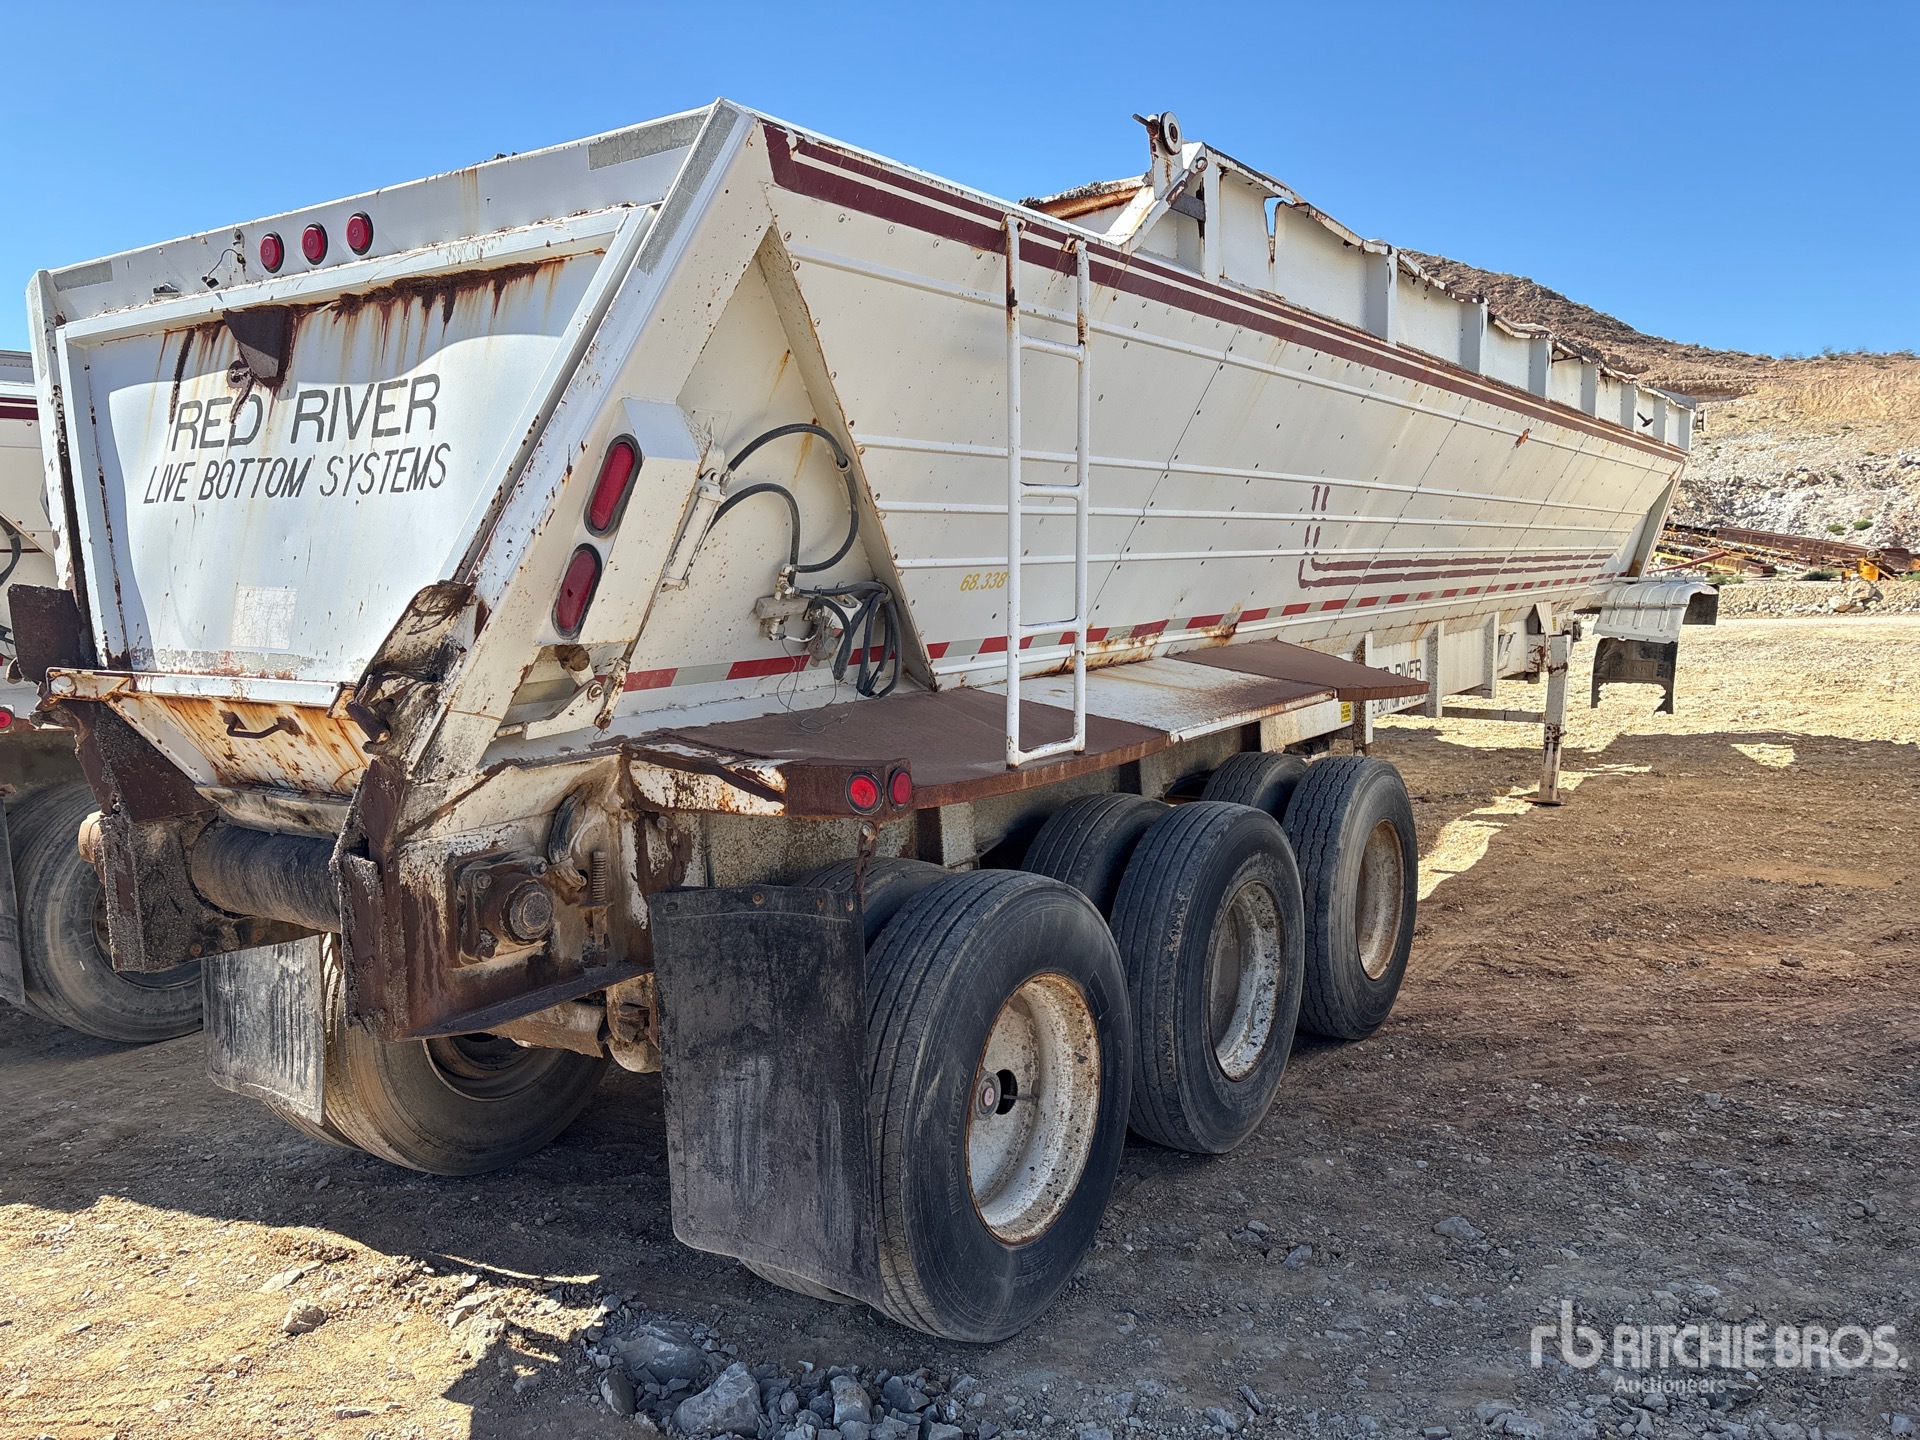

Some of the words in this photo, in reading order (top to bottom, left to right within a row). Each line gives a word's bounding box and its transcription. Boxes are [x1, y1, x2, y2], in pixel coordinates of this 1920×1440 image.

[171, 393, 263, 451] RED
[290, 374, 440, 444] RIVER
[143, 461, 196, 504] LIVE
[198, 456, 315, 500] BOTTOM
[319, 443, 451, 497] SYSTEMS
[960, 571, 1009, 592] 68.338
